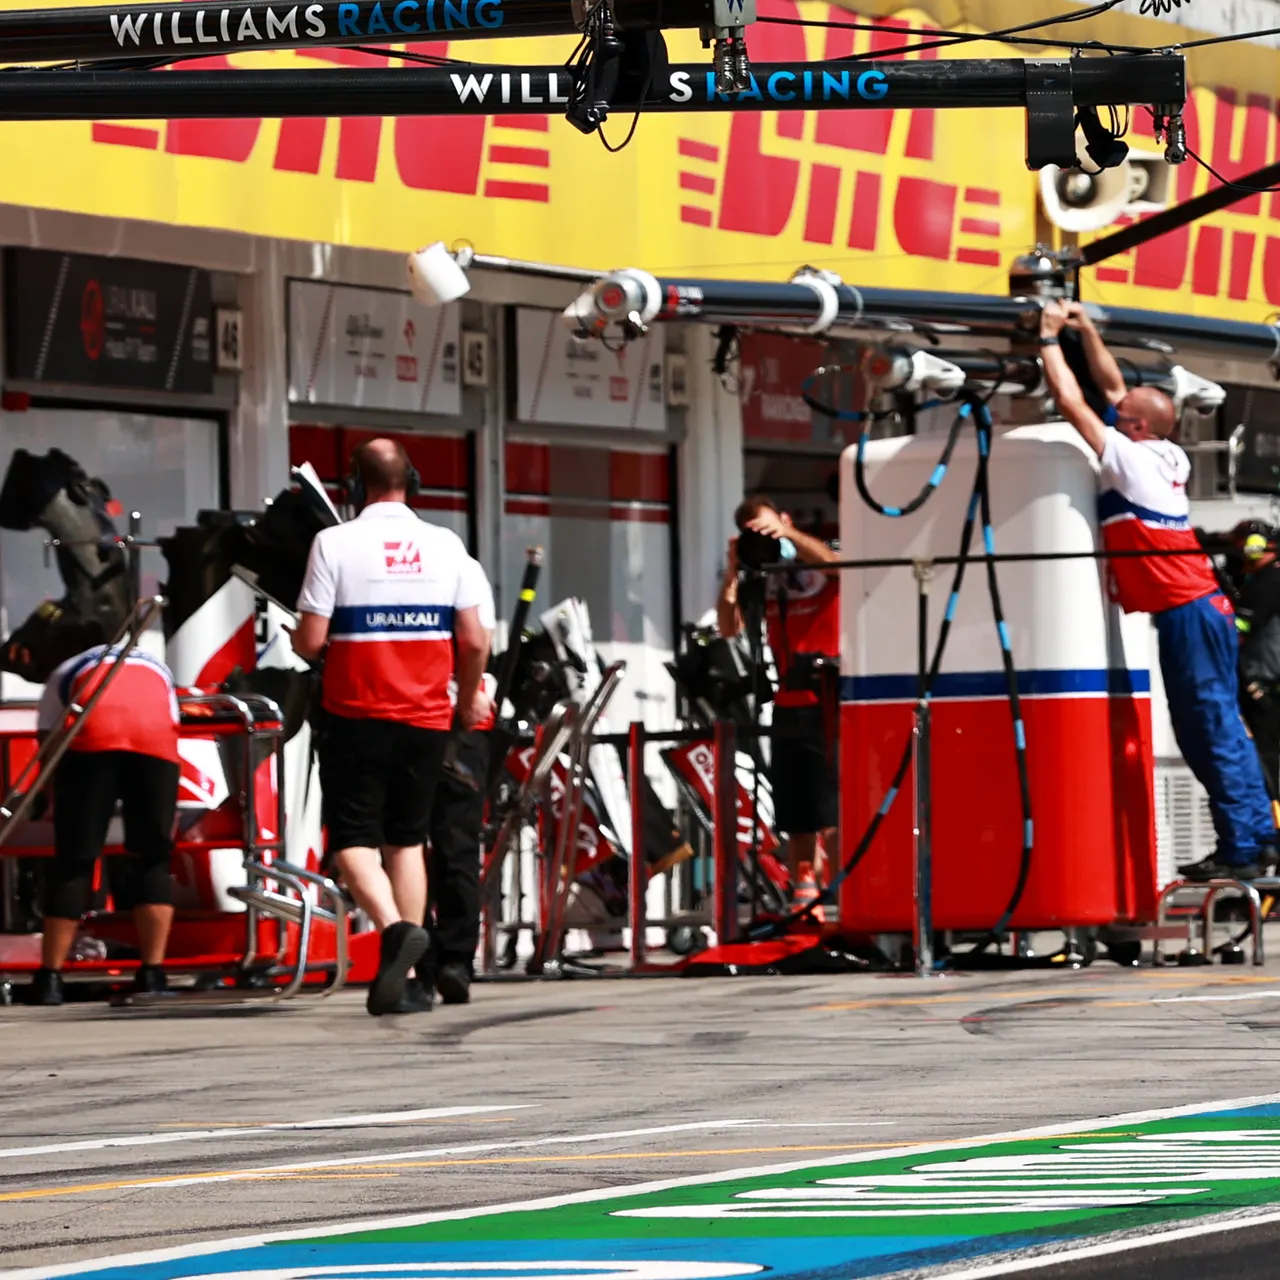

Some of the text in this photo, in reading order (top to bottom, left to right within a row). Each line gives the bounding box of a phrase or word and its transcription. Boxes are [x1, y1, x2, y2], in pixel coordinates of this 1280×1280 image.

[109, 4, 327, 47] WILLIAMS
[450, 71, 693, 105] WILLS
[366, 612, 441, 627] URALKALI
